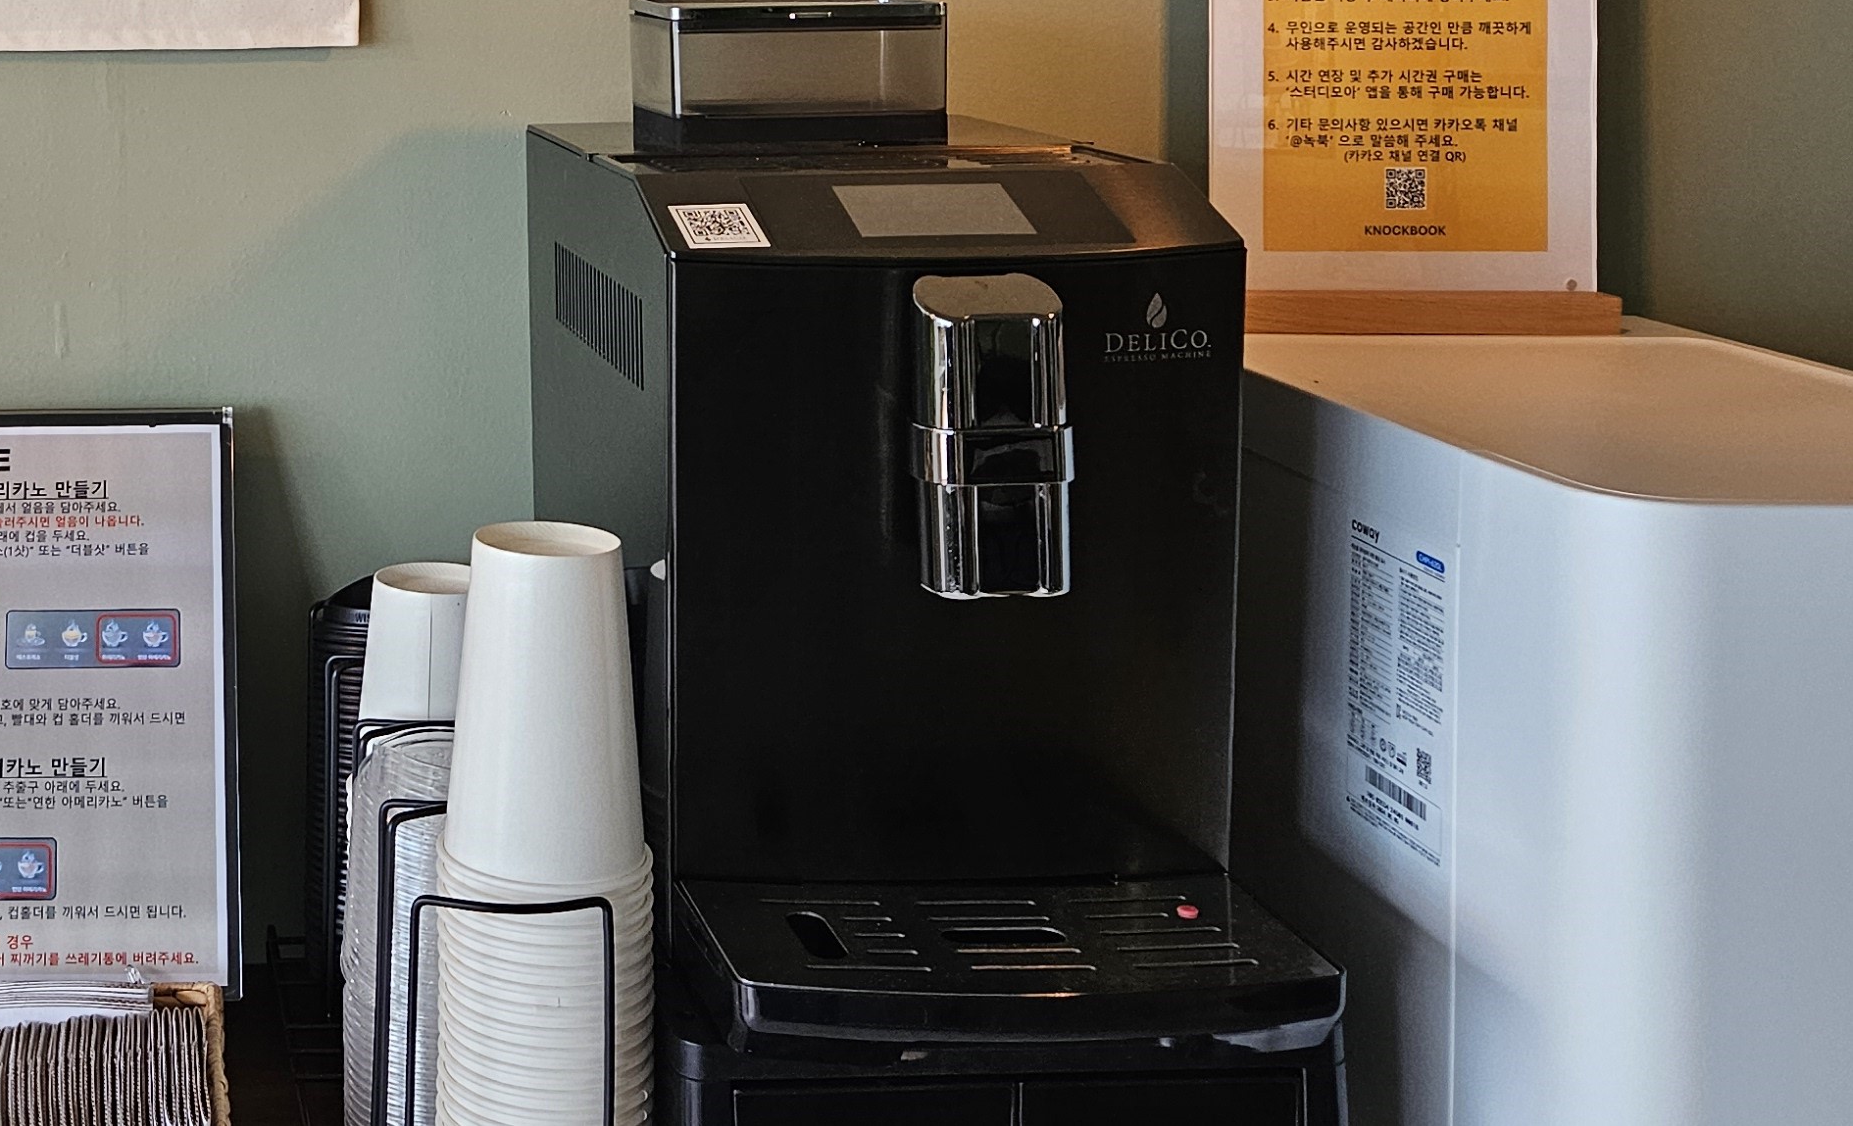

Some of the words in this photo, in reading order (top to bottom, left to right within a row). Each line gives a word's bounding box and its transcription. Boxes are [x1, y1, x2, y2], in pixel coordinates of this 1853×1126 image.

[1267, 23, 1279, 33] 4.
[1286, 21, 1339, 34] 무인으로
[1345, 21, 1397, 35] 운영되는
[1402, 21, 1441, 35] 공간인
[1448, 21, 1473, 35] 만큼
[1479, 21, 1531, 35] 깨끗하게
[1286, 37, 1365, 51] 사용해주시면
[1371, 37, 1467, 51] 감사하겠습니다.
[1268, 70, 1279, 82] 5.
[1286, 69, 1312, 83] 시간
[1318, 69, 1344, 83] 연장
[1350, 70, 1361, 83] 및
[1367, 70, 1393, 83] 추가
[1399, 69, 1437, 83] 시간권
[1443, 70, 1482, 83] 구매는
[1365, 86, 1391, 99] 앱을
[1397, 86, 1422, 99] 통해
[1428, 86, 1453, 99] 구매
[1460, 85, 1529, 99] 가능합니다.
[1268, 119, 1279, 130] 6.
[1287, 118, 1313, 131] 기타
[1317, 118, 1371, 132] 문의사항
[1376, 118, 1428, 132] 있으시면
[1434, 118, 1486, 132] 카카오톡
[1493, 118, 1517, 132] 채널
[1338, 135, 1365, 146] 으로
[1370, 134, 1408, 148] 말씀해
[1414, 134, 1458, 148] 주세요.
[1389, 150, 1411, 162] 채널
[1417, 150, 1440, 162] 연결
[1445, 150, 1466, 163] QR)
[1365, 225, 1446, 236] KNOCKBOOK
[1161, 350, 1211, 360] MACHINE
[56, 479, 107, 499] 만들기
[21, 501, 55, 515] 얼음을
[61, 501, 120, 514] 담아주세요.
[56, 514, 89, 529] 얼음이
[95, 514, 144, 528] 나옵니다.
[25, 529, 47, 543] 컵을
[52, 529, 89, 543] 두세요.
[39, 544, 61, 557] 또는
[115, 543, 149, 556] 버튼을
[29, 697, 52, 711] 맞게
[58, 697, 120, 712] 담아주세요.
[53, 712, 63, 726] 컵
[110, 711, 144, 726] 끼워서
[150, 711, 185, 726] 드시면
[52, 756, 105, 778] 만들기
[3, 781, 39, 795] 추출구
[42, 779, 79, 794] 아래에
[85, 780, 124, 794] 두세요.
[133, 794, 168, 809] 버튼을
[62, 905, 98, 921] 끼워서
[105, 905, 140, 920] 드시면
[147, 905, 186, 920] 됩니다.
[7, 935, 33, 950] 경우
[11, 952, 59, 967] 찌꺼기를
[65, 951, 127, 966] 쓰레기통에
[133, 950, 198, 966] 버려주세요.
